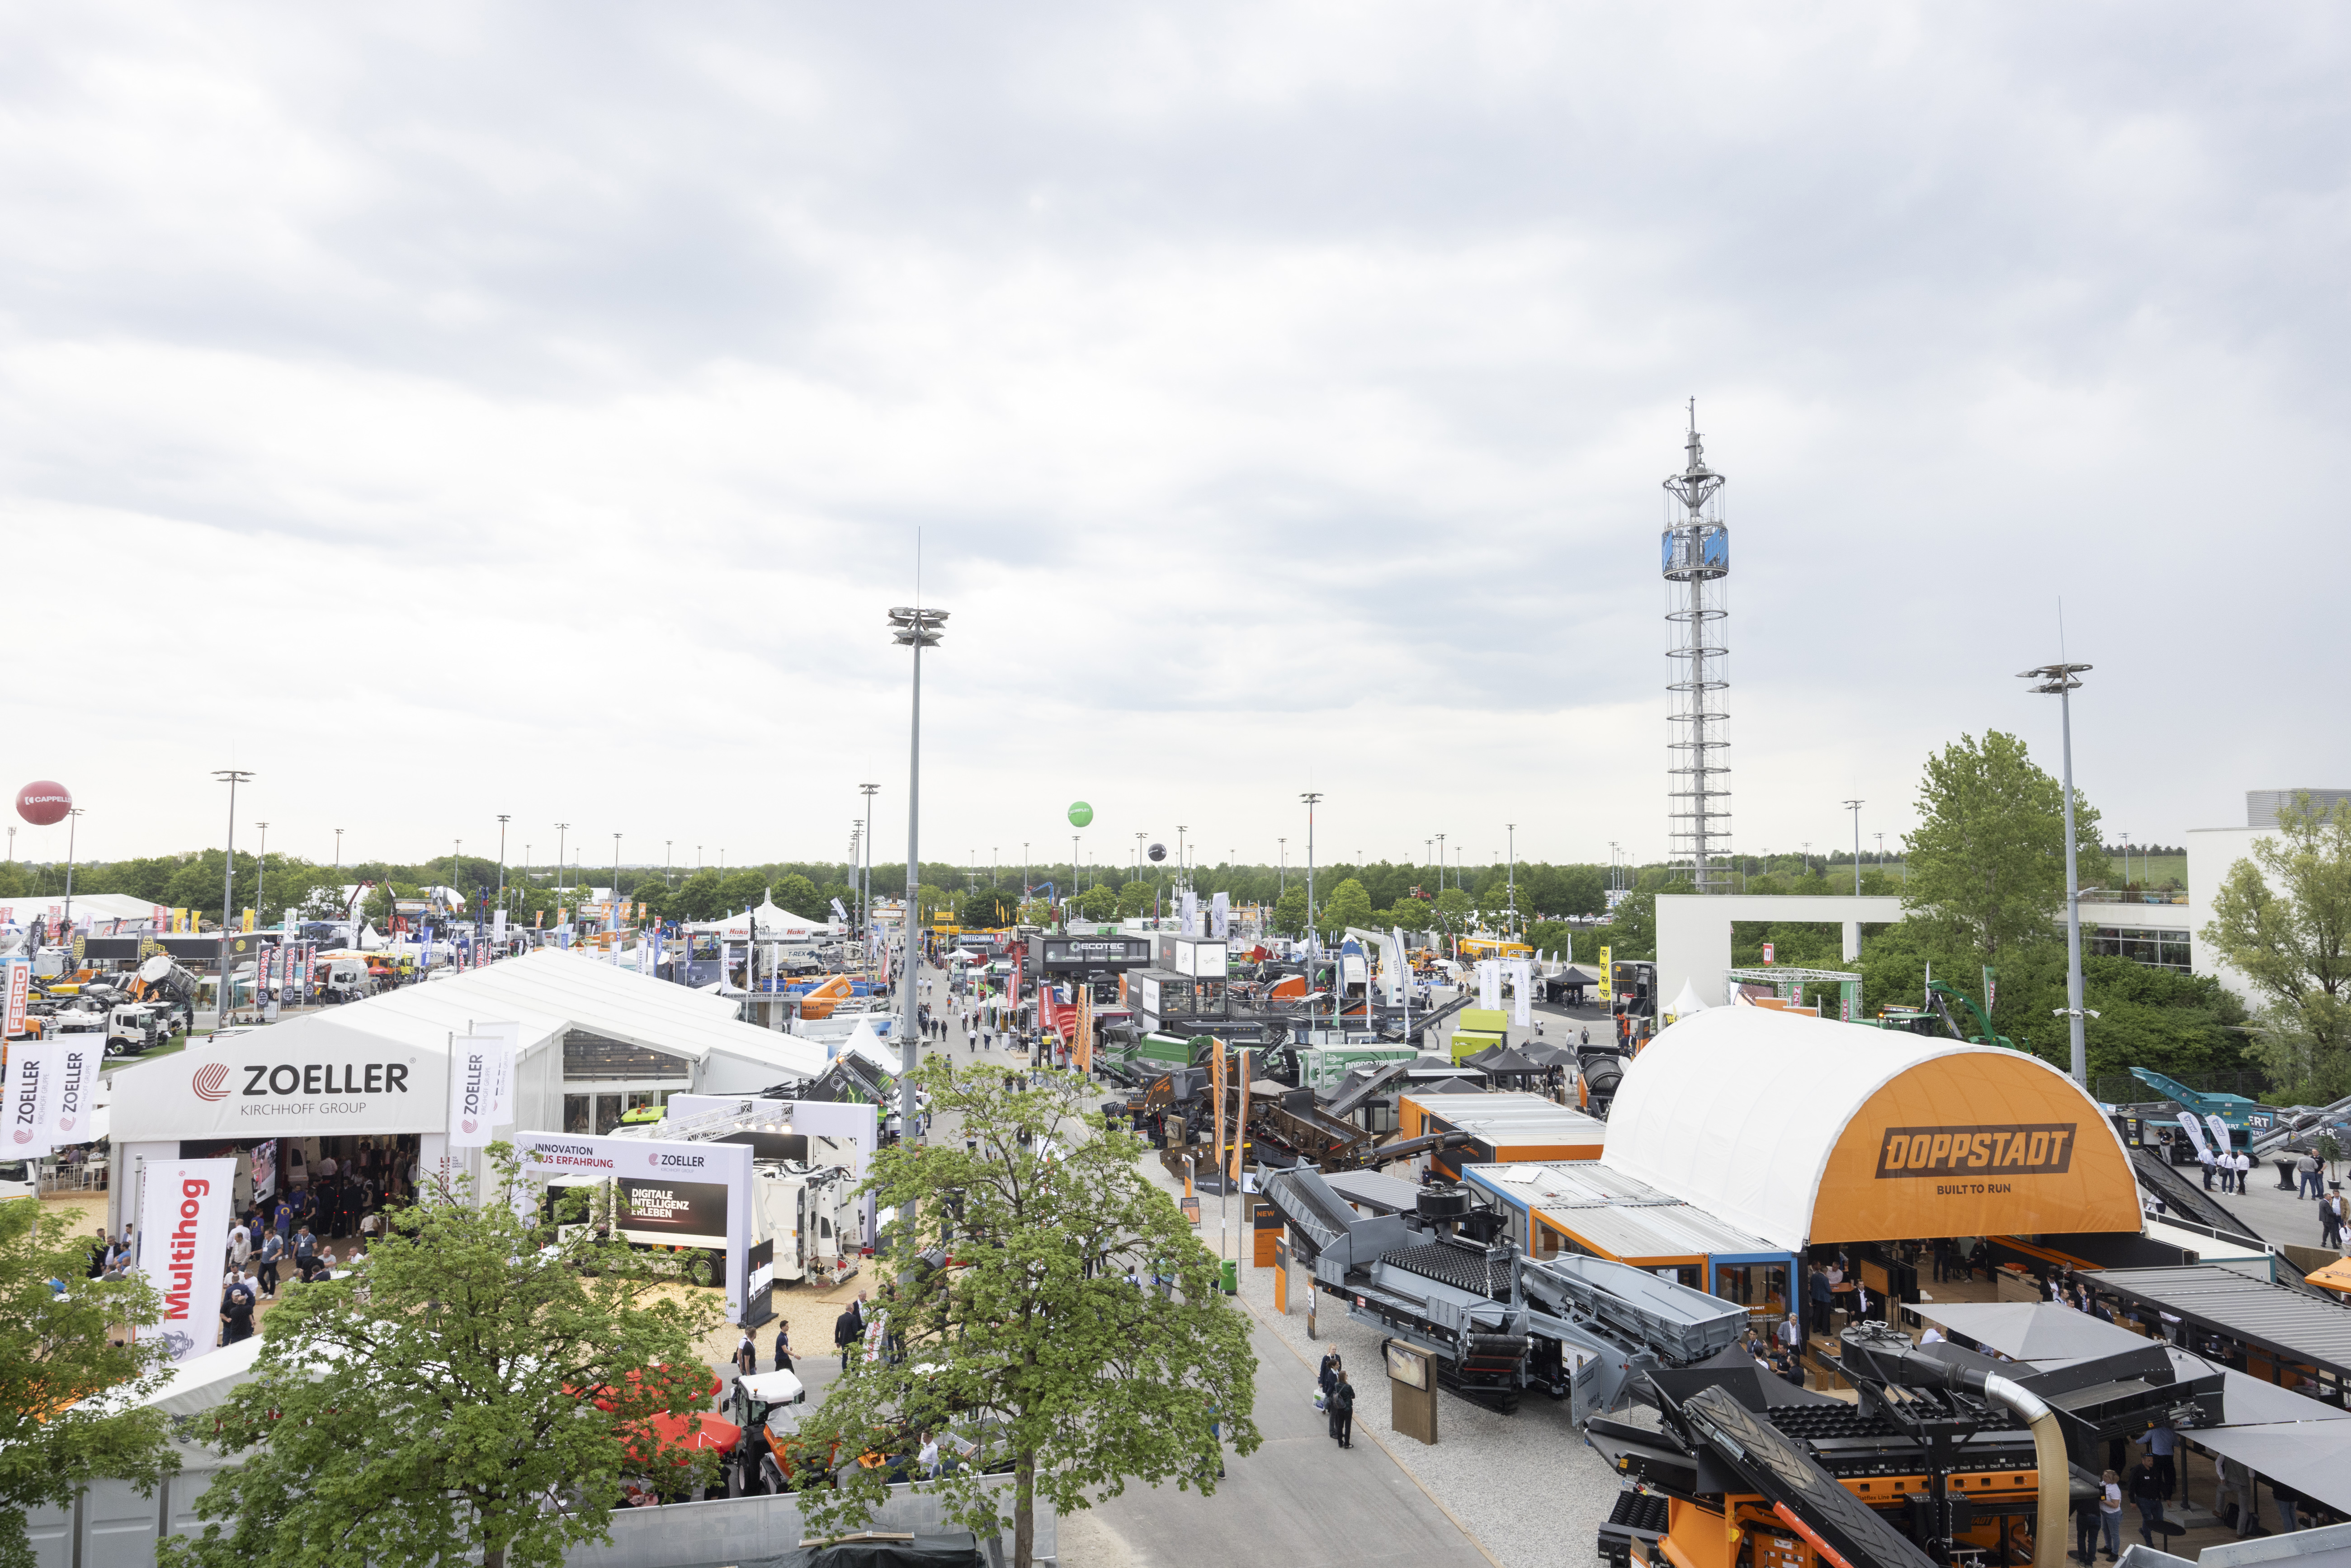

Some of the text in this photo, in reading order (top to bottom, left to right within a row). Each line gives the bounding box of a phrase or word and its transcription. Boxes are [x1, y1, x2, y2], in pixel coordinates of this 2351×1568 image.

[259, 949, 270, 989] HANSA
[285, 947, 295, 986] HANSA
[306, 945, 316, 983] HANSA
[476, 943, 484, 969] ANSA
[10, 969, 26, 1029] FERRO
[1073, 997, 1083, 1055] DOPPSTADT
[17, 1061, 40, 1124] ZOELLER
[62, 1053, 83, 1112] ZOELLER
[242, 1063, 408, 1096] ZOELLER
[464, 1055, 483, 1115] ZOELLER
[38, 1095, 47, 1124] KIRCHHOFF
[241, 1102, 366, 1116] KIRCHHOFF GROUP
[535, 1143, 593, 1155] INNOVATION
[537, 1155, 615, 1168] US ERFAHRUNG.
[662, 1155, 704, 1167] ZOELLER
[1884, 1131, 2069, 1169] DOPPSTADT
[632, 1188, 673, 1200] DIGITALE
[632, 1197, 689, 1210] INTELLIGENZ
[1937, 1183, 2011, 1195] BUILT TO RUN
[165, 1179, 210, 1320] Multihog
[1588, 1394, 1596, 1407] SWS
